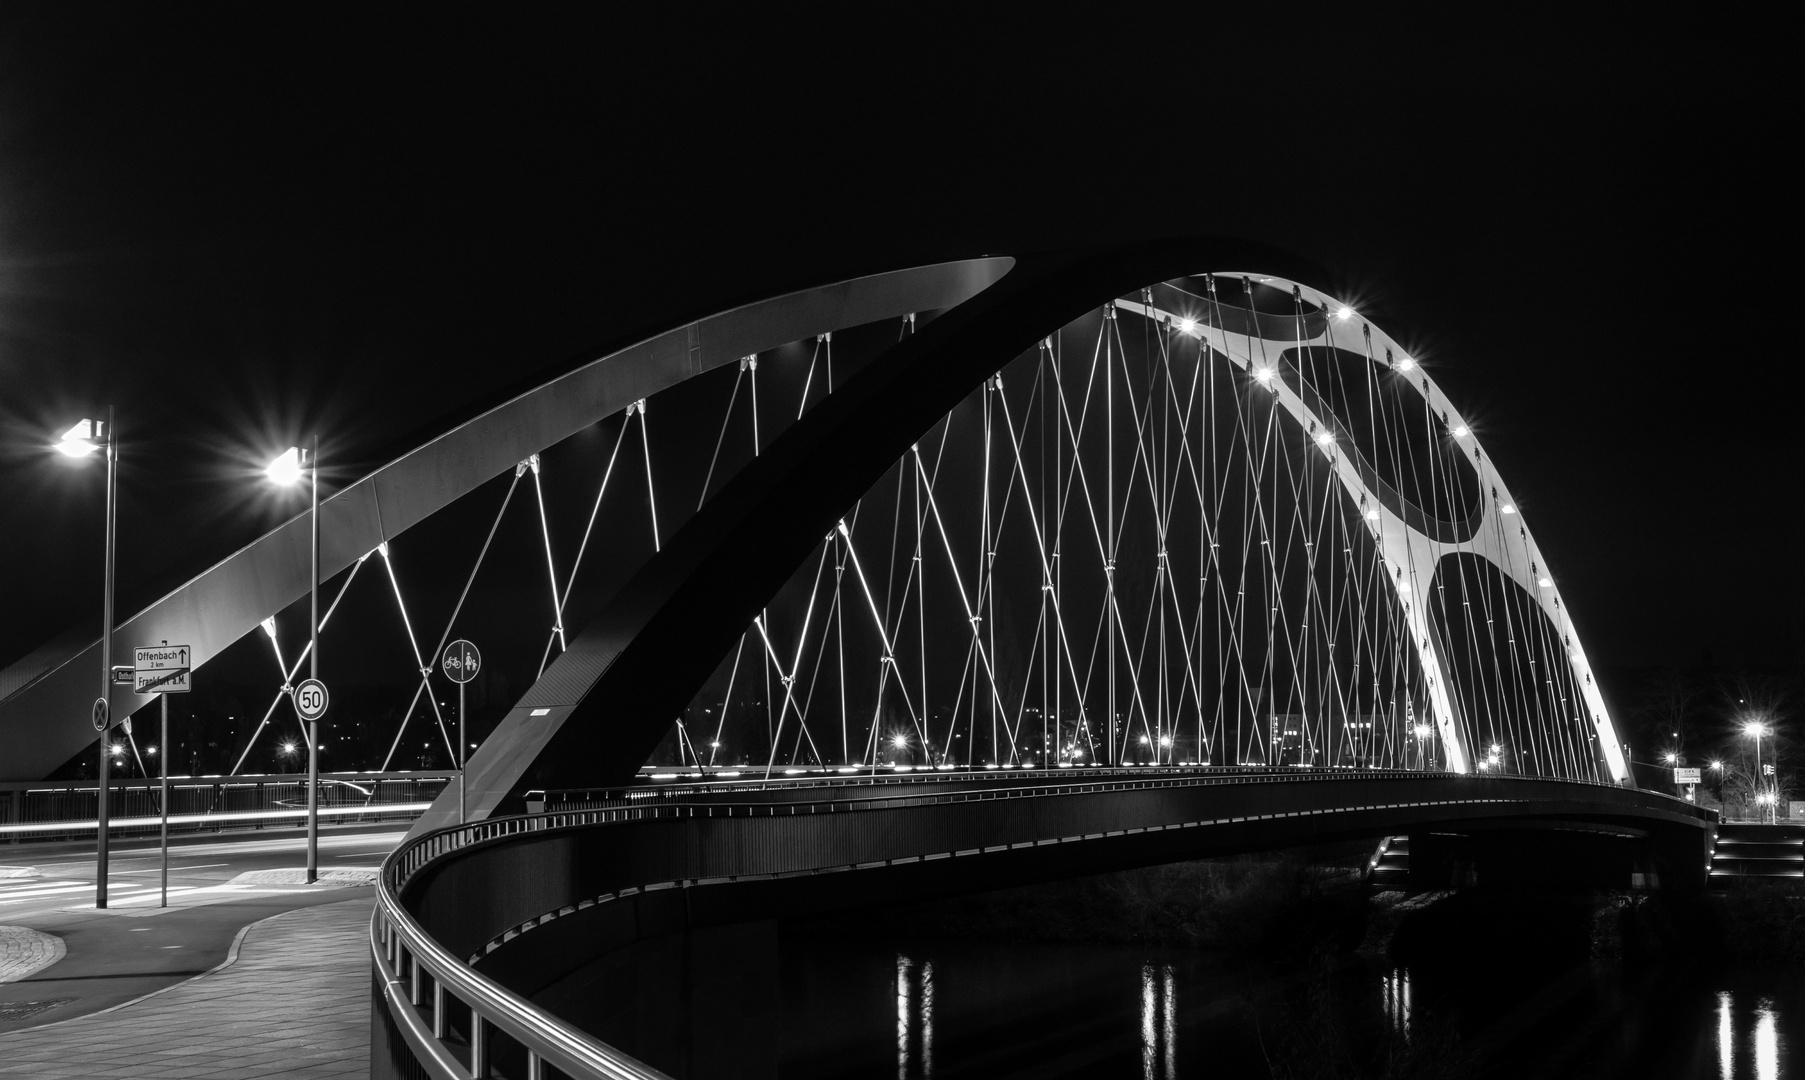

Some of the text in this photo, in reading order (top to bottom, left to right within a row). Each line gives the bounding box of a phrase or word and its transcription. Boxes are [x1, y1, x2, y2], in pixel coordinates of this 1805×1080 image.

[137, 650, 177, 661] Offenbach
[138, 675, 186, 687] Frankfurt a.M.
[302, 691, 321, 709] 50
